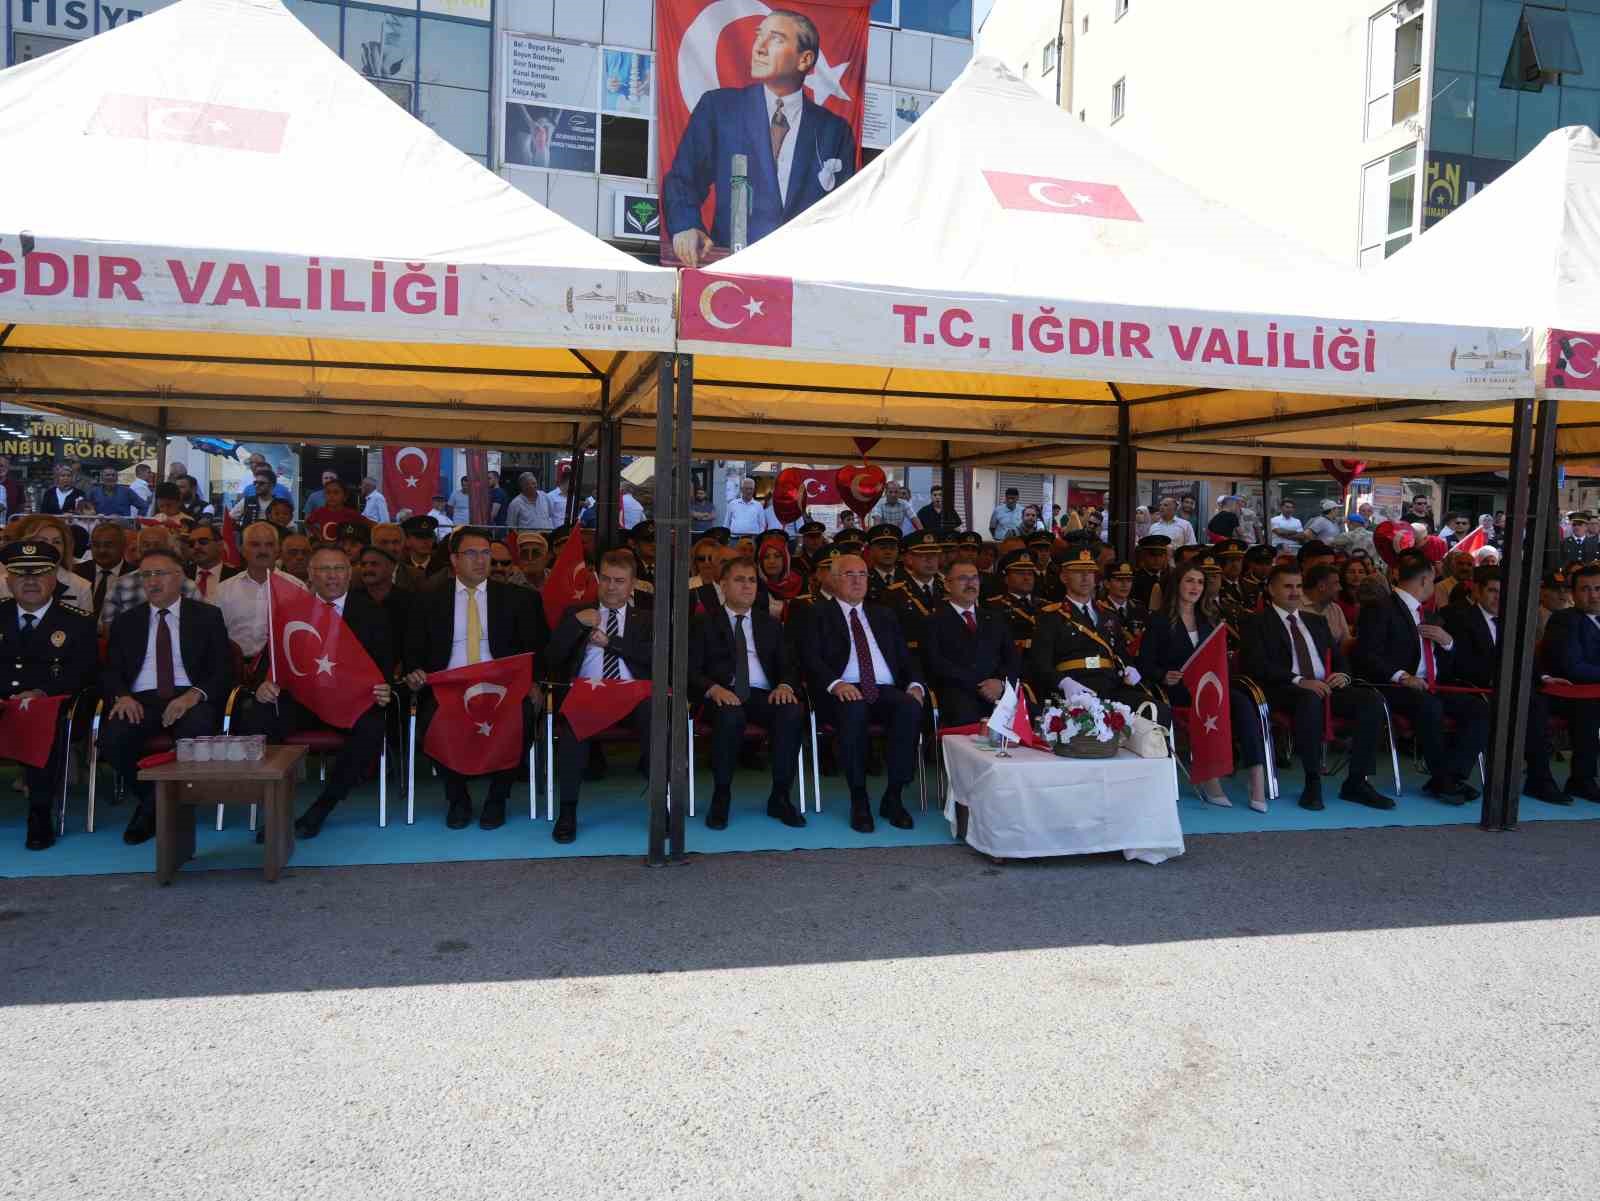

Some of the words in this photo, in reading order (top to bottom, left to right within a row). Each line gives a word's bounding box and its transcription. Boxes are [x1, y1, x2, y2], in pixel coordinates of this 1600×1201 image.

[166, 256, 459, 317] VALİLİĞİ
[1011, 305, 1154, 359] IĞDIR
[1168, 322, 1376, 373] VALİLİĞİ
